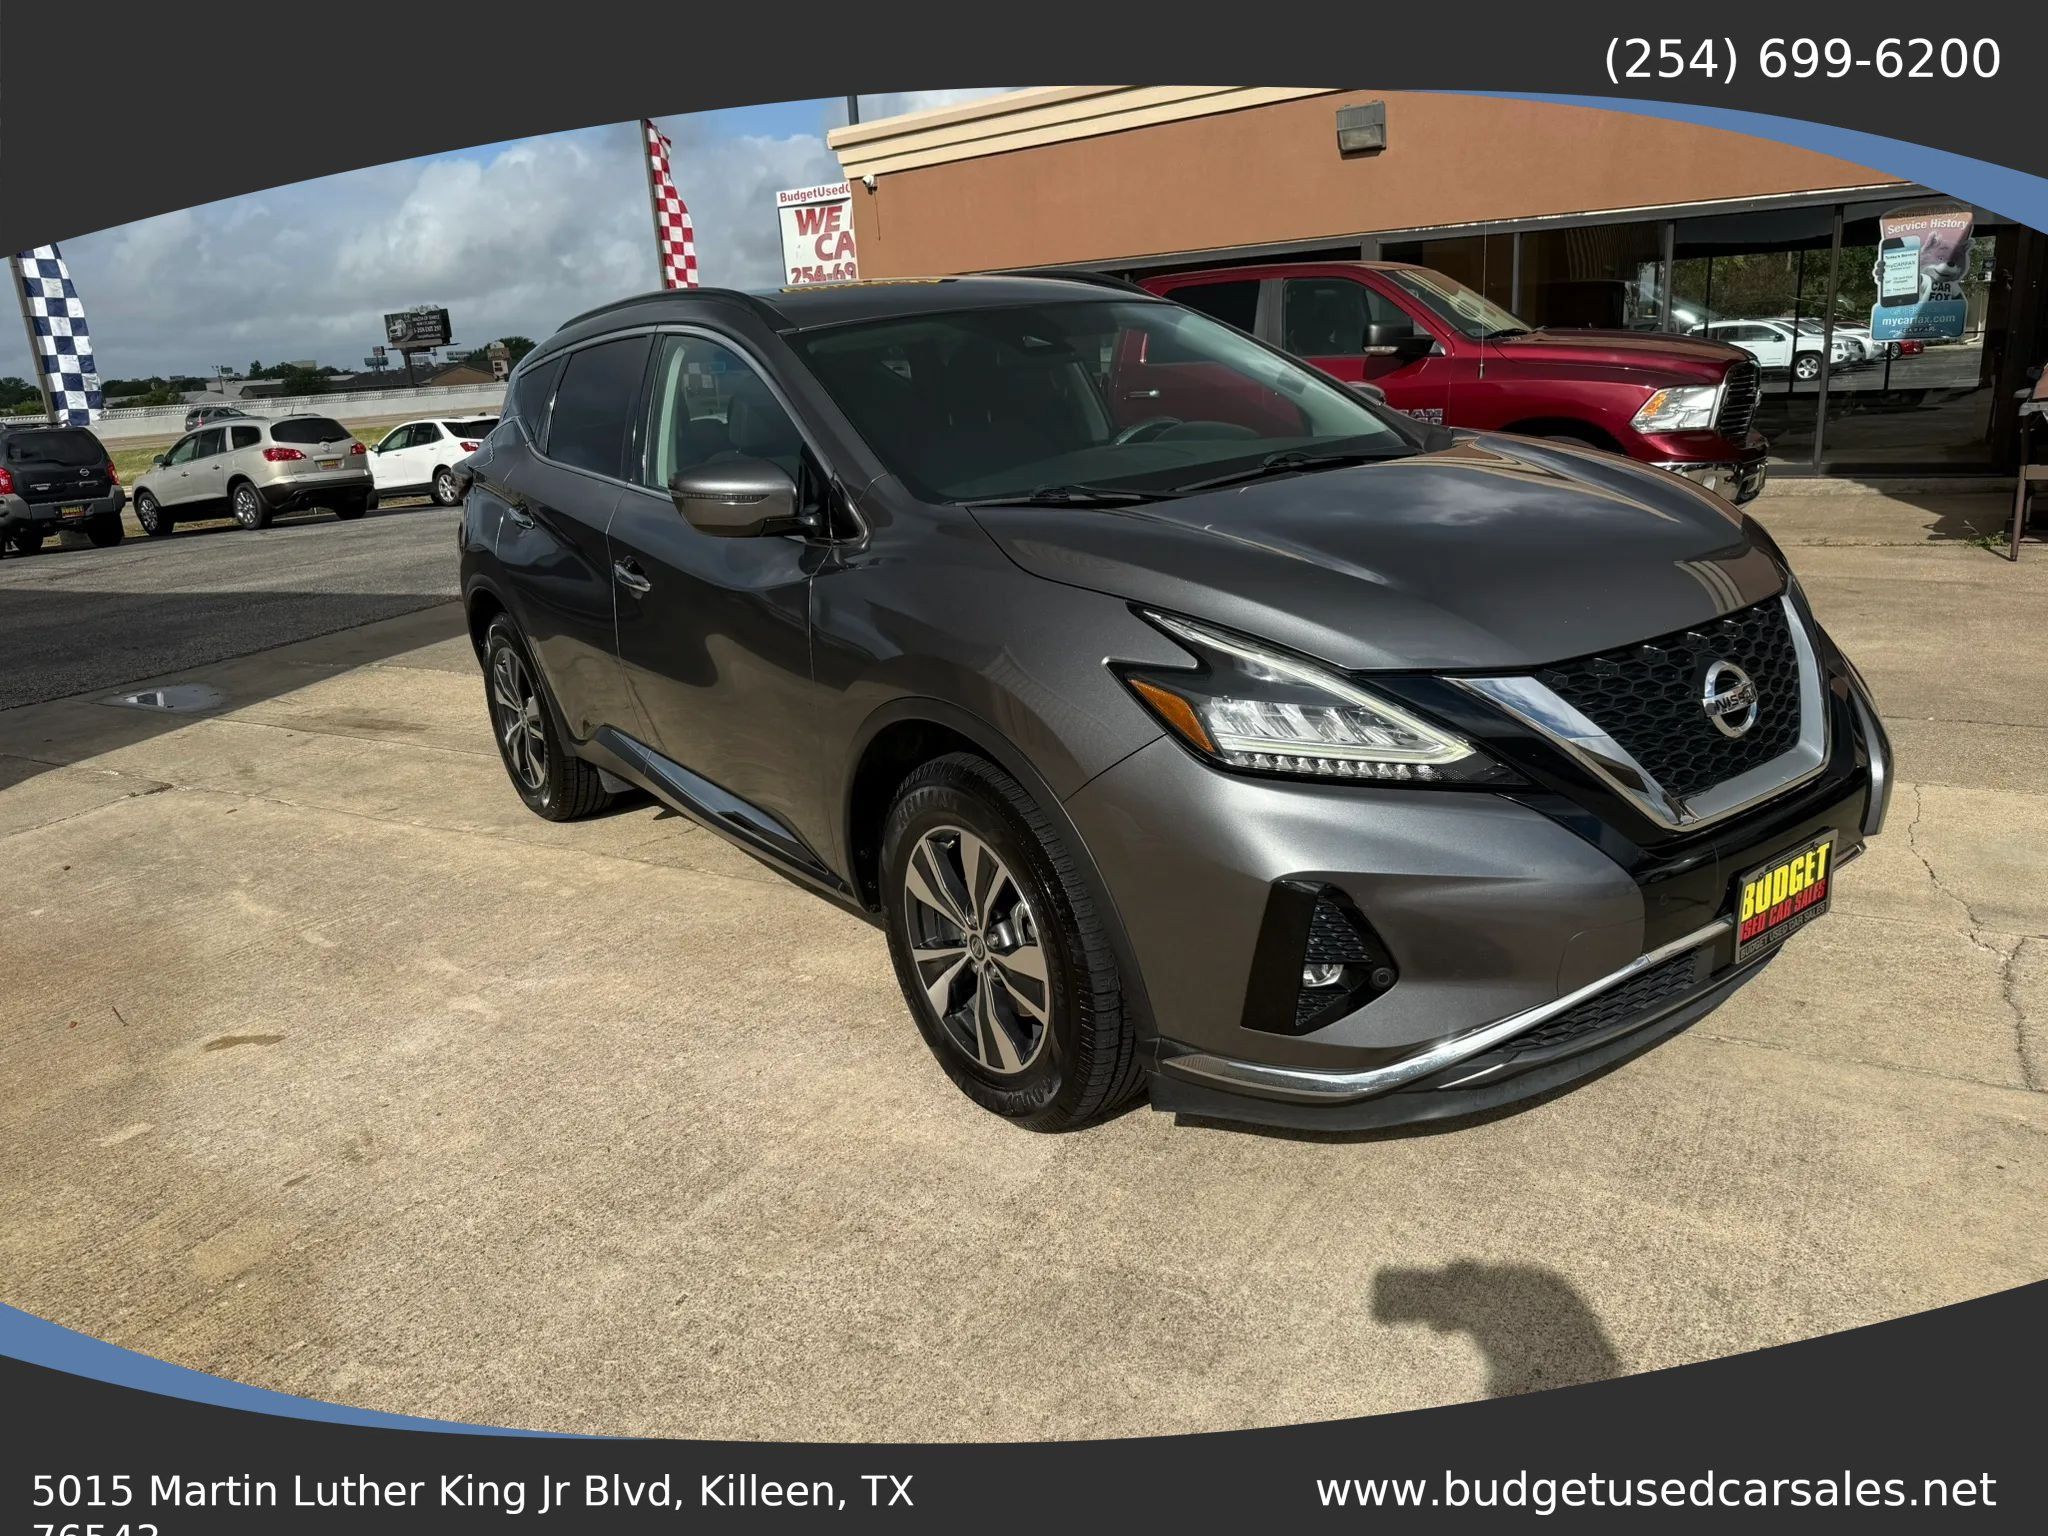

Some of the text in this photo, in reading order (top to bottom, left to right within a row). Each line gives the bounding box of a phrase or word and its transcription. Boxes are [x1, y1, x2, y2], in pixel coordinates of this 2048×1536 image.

[795, 206, 842, 236] WE
[1887, 218, 1969, 235] Service History
[1928, 292, 1951, 301] FOX
[1931, 281, 1951, 292] CAR
[1741, 842, 1830, 923] BUDGET
[1768, 897, 1792, 927] CAR
[1793, 879, 1826, 912] SALES
[1740, 902, 1826, 959] BUDGET USED CAR SALES
